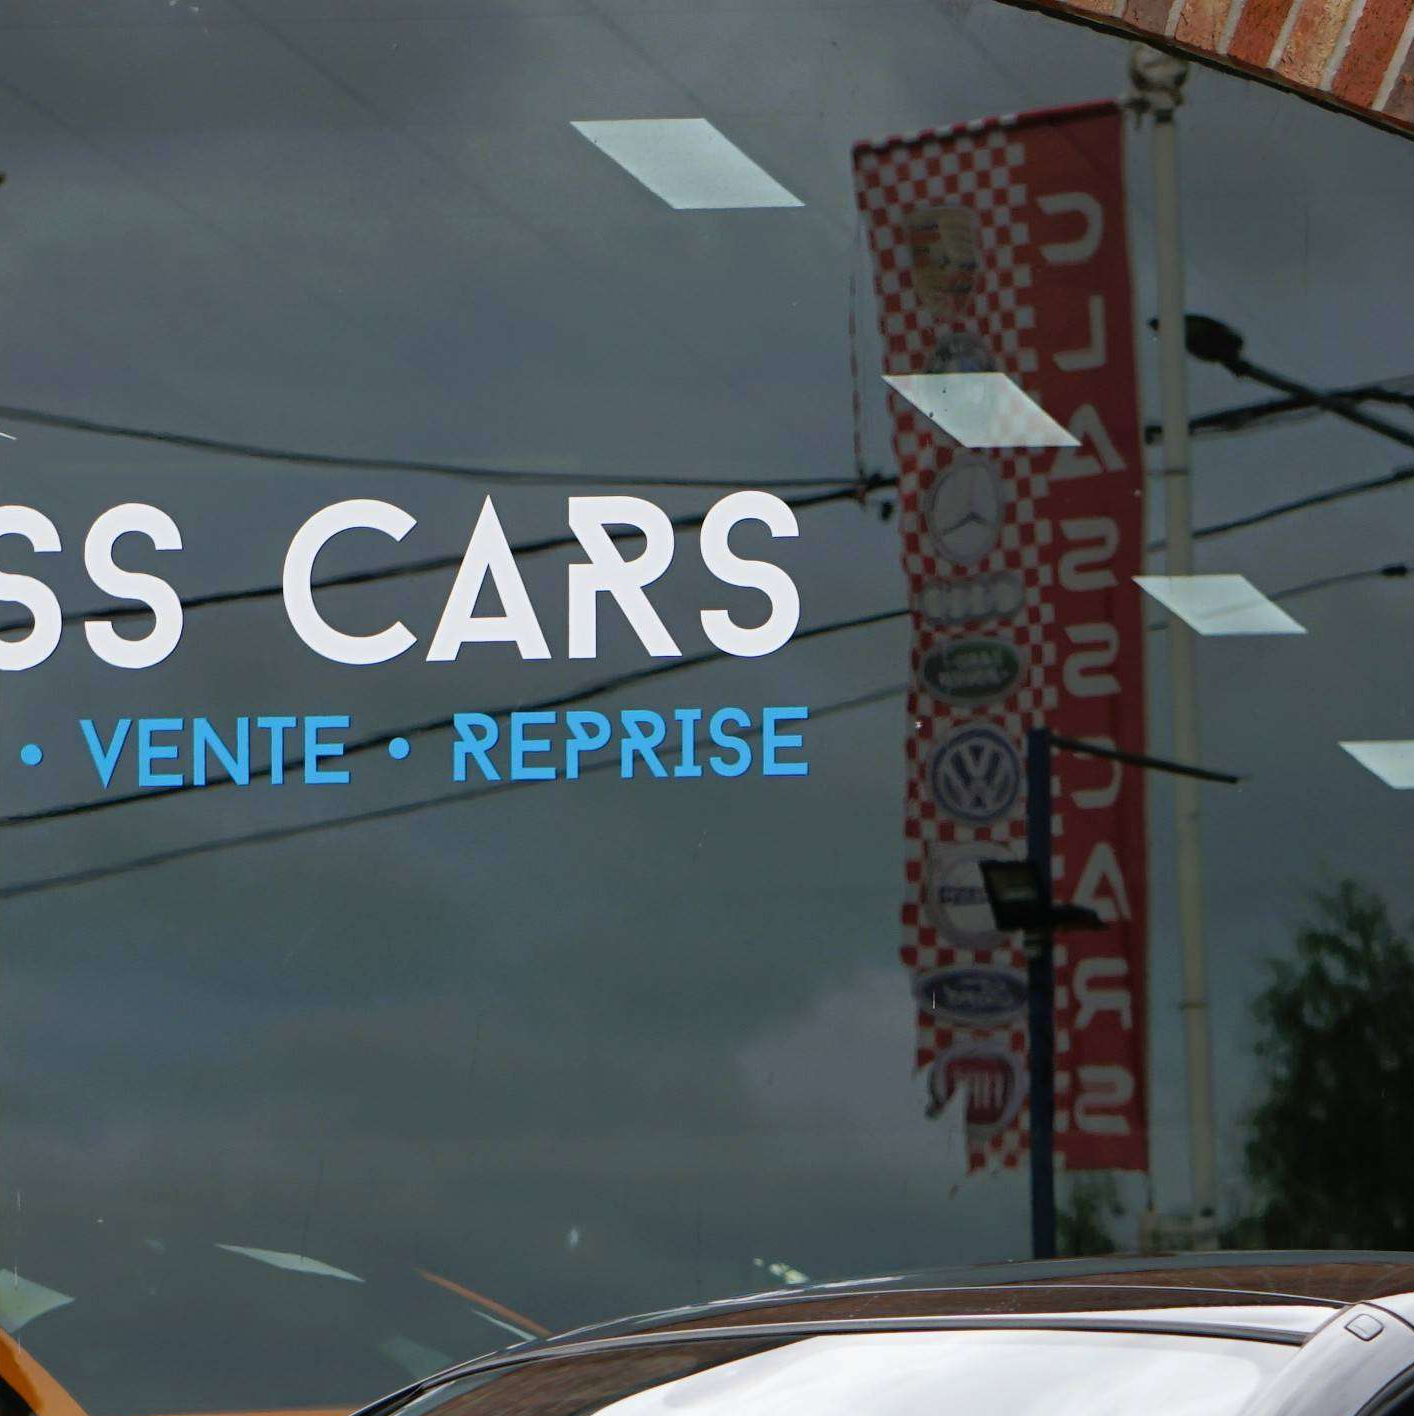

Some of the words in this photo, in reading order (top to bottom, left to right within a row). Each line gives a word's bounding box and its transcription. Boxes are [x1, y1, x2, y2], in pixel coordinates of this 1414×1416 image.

[282, 490, 800, 665] CARS
[78, 714, 351, 790] VENTE
[450, 705, 809, 784] REPRISE
